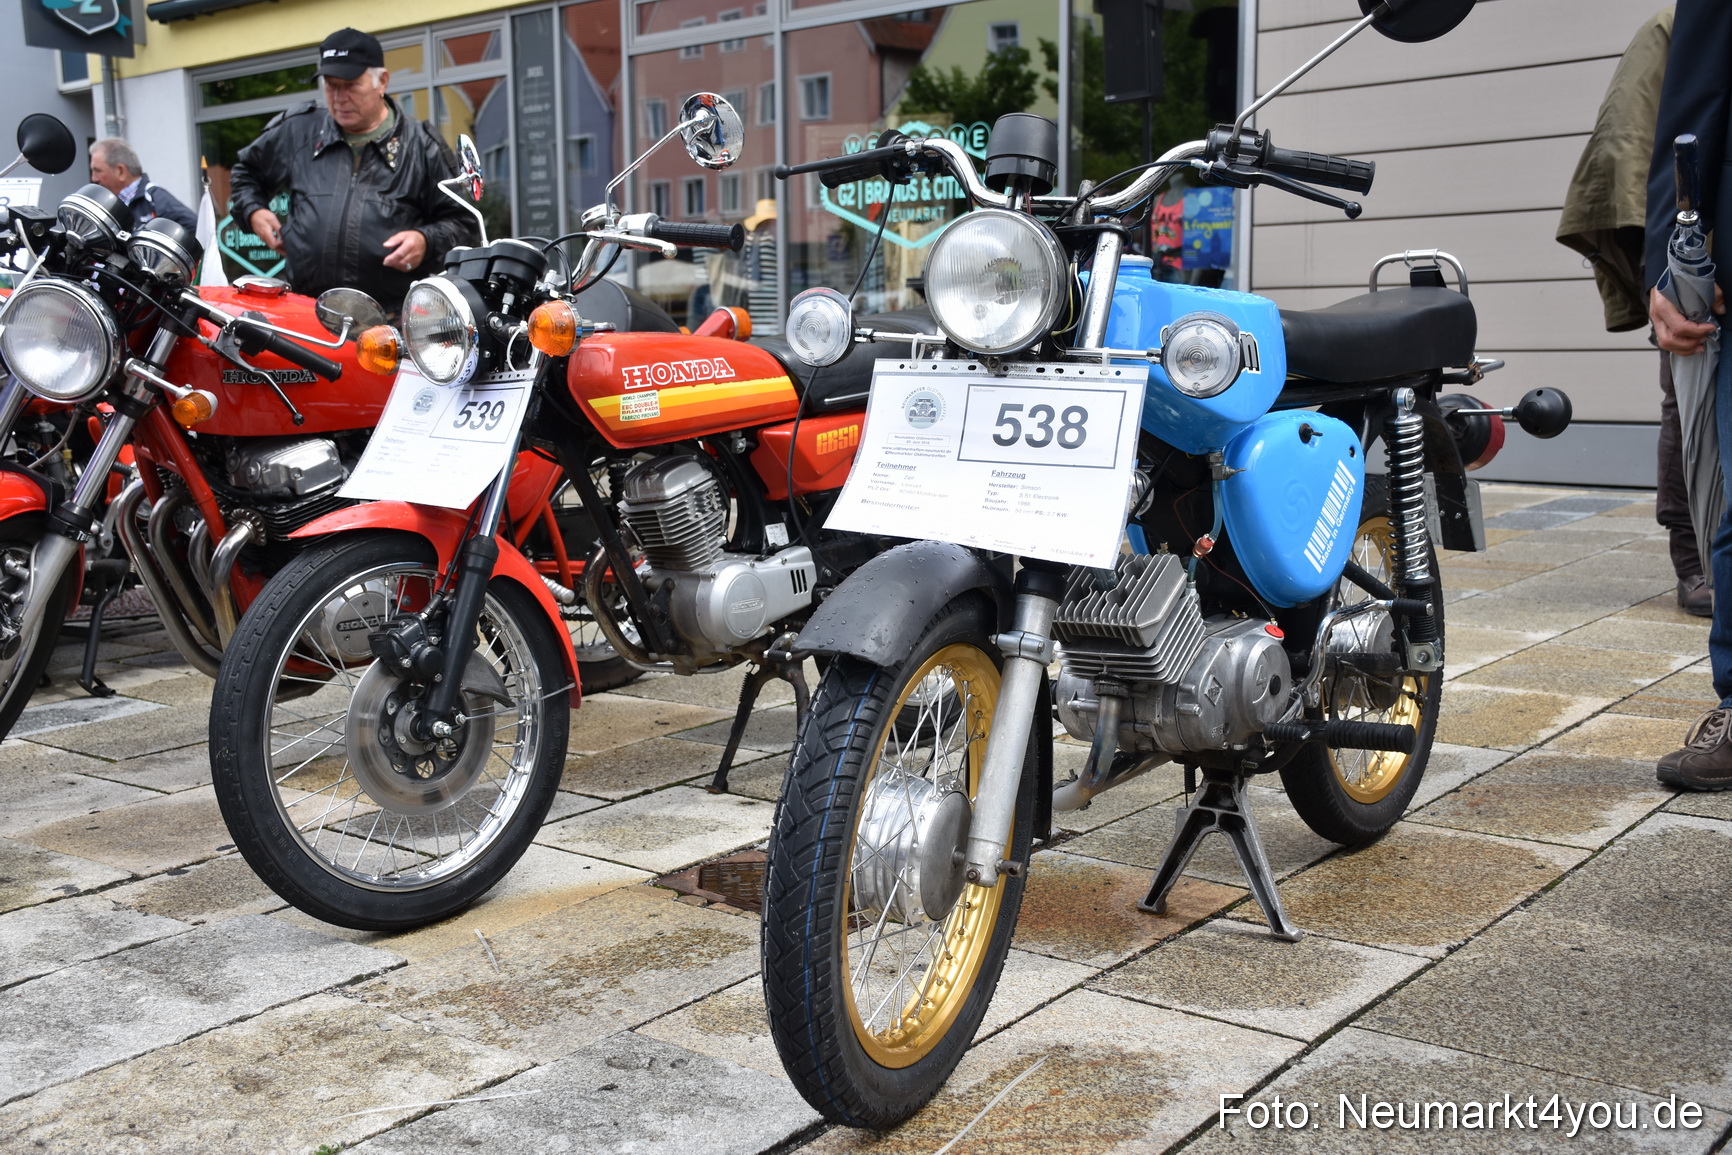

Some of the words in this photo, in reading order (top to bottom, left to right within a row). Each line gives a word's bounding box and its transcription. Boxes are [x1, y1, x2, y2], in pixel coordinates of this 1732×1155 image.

[865, 177, 919, 205] BRANDS
[920, 177, 932, 201] &
[223, 369, 319, 384] HONDA
[621, 357, 736, 390] HONDA
[453, 400, 505, 431] 539
[992, 403, 1089, 450] 538
[876, 461, 917, 471] Teilnehmer
[991, 470, 1026, 480] Fahrzeug
[1319, 540, 1334, 566] Made
[1331, 528, 1339, 540] in
[1335, 484, 1355, 527] Germany
